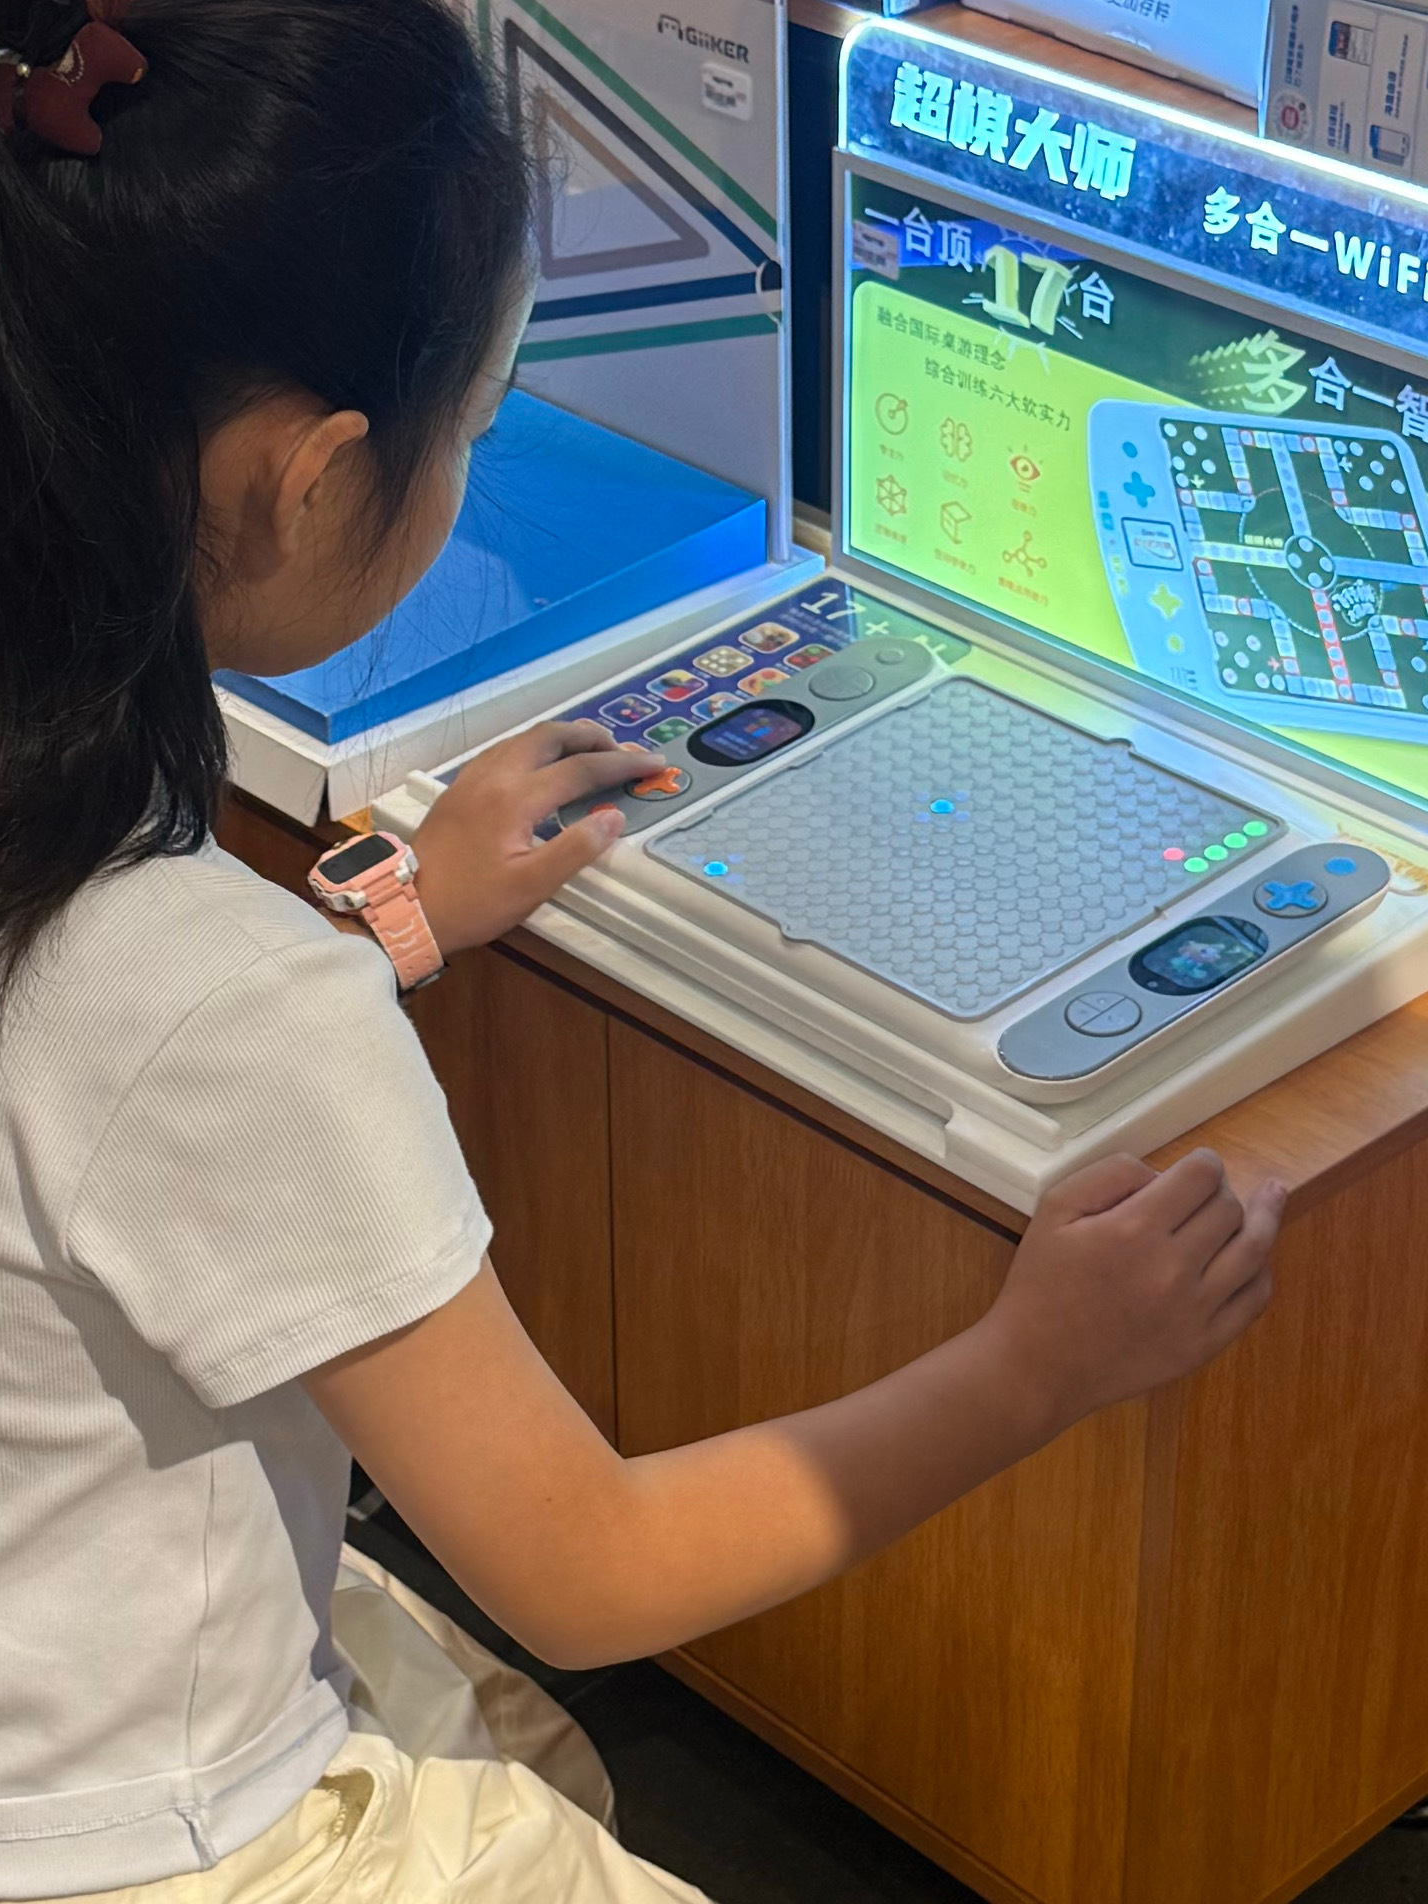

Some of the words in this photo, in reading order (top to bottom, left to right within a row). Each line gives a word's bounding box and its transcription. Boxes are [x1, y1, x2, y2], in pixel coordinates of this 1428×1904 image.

[889, 61, 1136, 201] 超棋大师
[923, 356, 1071, 432] 综合训练六大软实力
